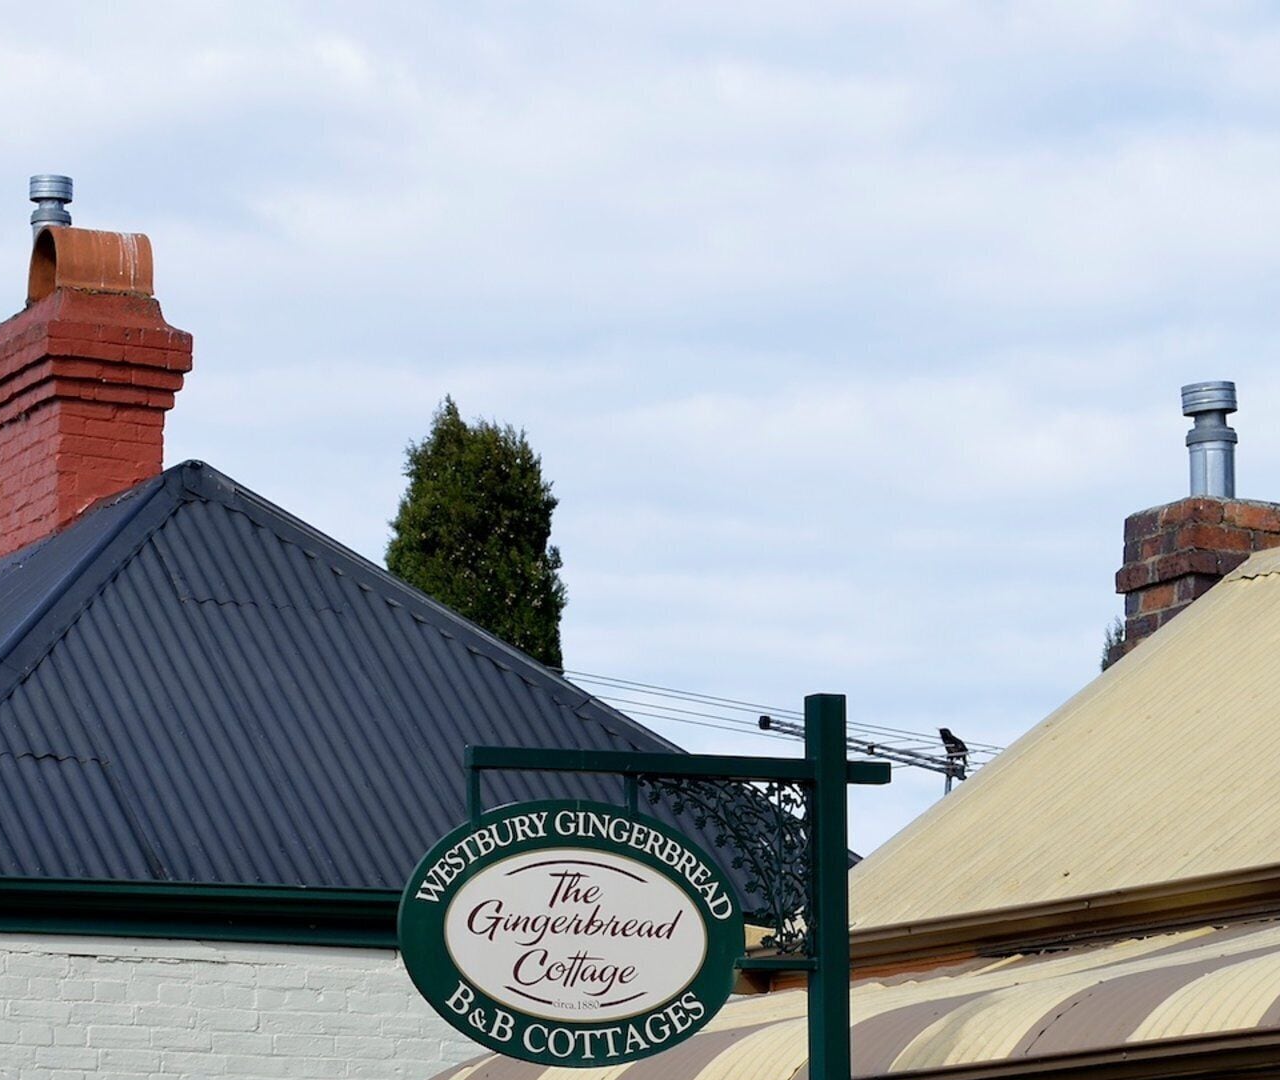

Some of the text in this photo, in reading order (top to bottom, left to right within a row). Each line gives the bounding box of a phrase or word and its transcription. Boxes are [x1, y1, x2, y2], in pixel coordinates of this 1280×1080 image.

[415, 810, 733, 920] WESTBURY GINGERBREAD
[548, 869, 603, 909] The
[466, 899, 684, 946] Gingerbread
[512, 949, 641, 996] Cottage
[445, 980, 705, 1059] B&B COTTAGES
